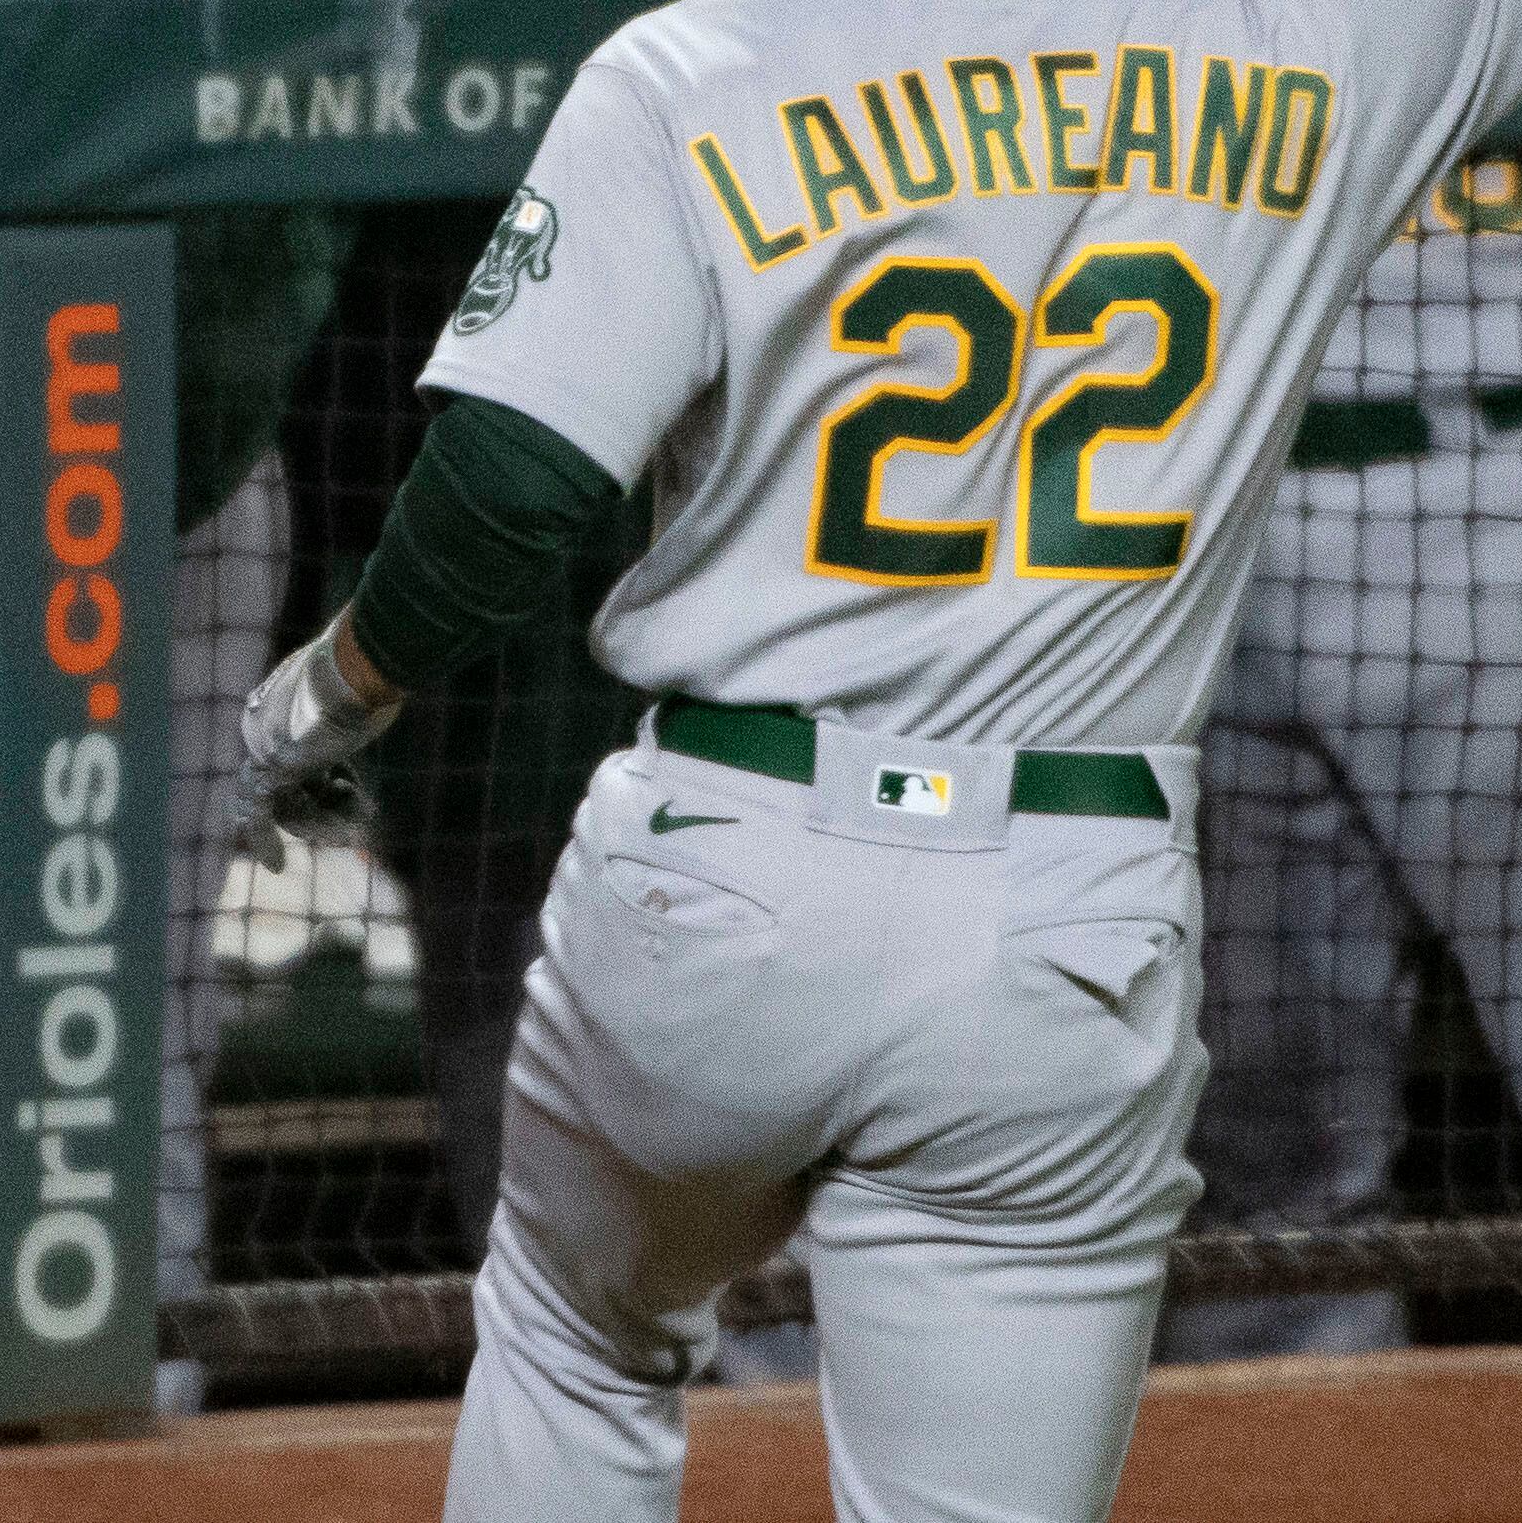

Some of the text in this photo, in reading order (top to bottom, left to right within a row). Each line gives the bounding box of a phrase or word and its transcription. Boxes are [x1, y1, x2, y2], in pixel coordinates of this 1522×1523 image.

[195, 63, 550, 142] BANK OF
[688, 42, 1335, 275] LAUREANO
[803, 241, 1221, 587] 22
[16, 303, 124, 1344] Orioles.com
